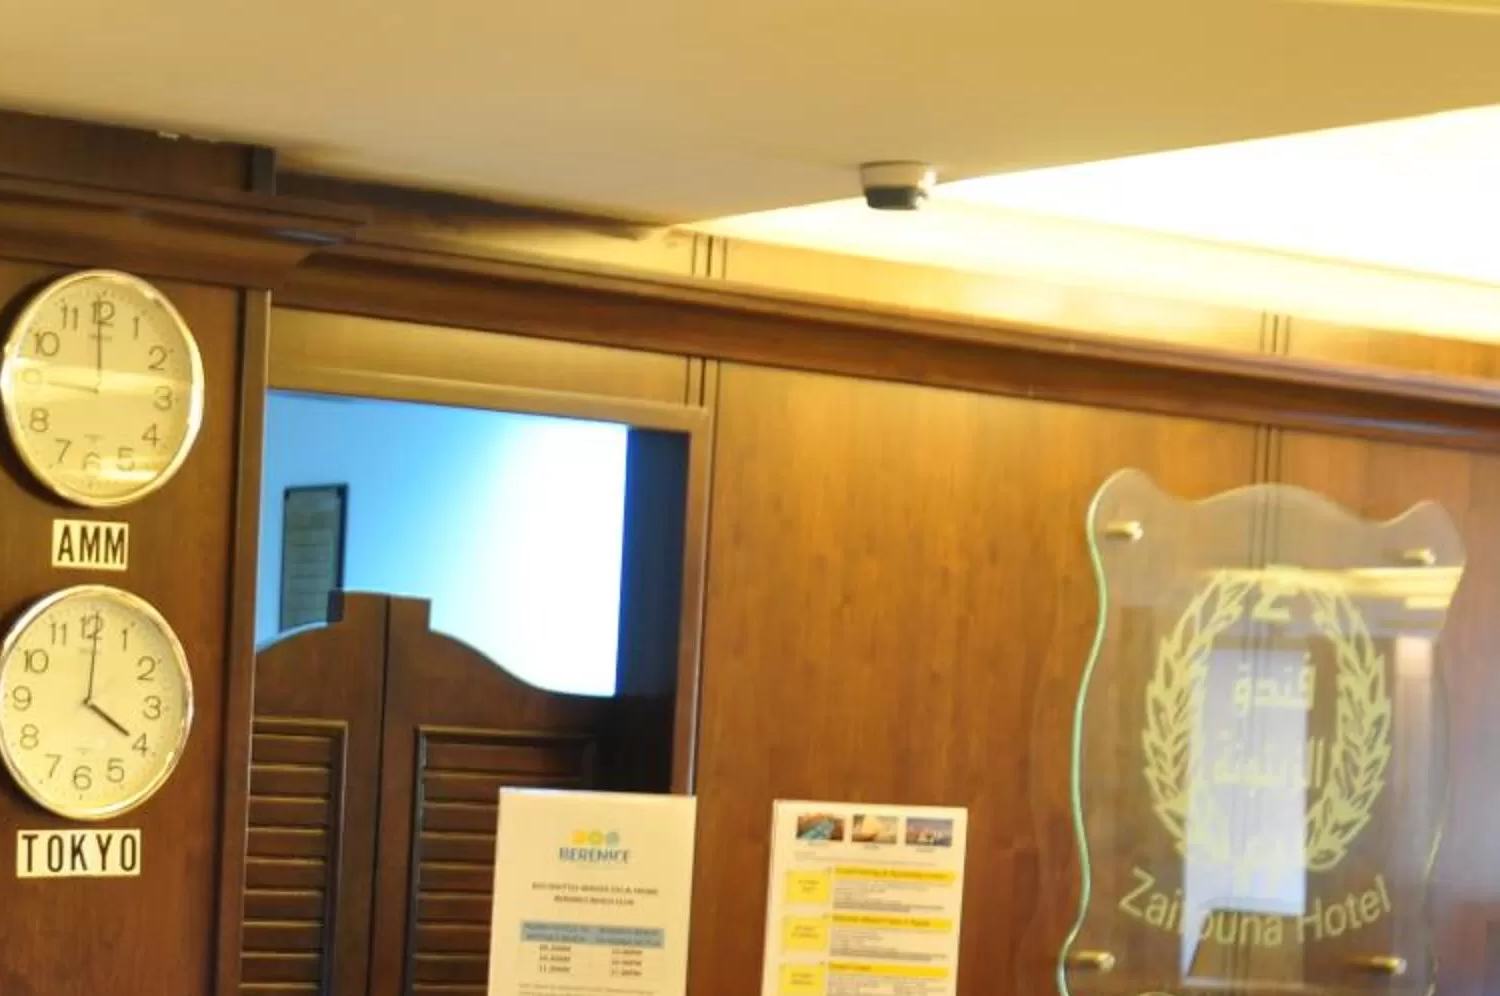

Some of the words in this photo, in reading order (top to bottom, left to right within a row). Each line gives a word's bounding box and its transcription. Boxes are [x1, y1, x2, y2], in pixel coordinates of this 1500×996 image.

[60, 304, 78, 331] 11
[90, 300, 116, 326] 12
[132, 316, 140, 340] 1
[34, 331, 60, 356] 10
[148, 346, 168, 371] 2
[153, 386, 172, 411] 3
[30, 408, 50, 433] 8
[141, 423, 161, 448] 4
[55, 438, 72, 464] 7
[57, 525, 125, 564] AMM
[50, 622, 67, 645] 11
[80, 614, 104, 640] 12
[120, 628, 128, 651] 1
[24, 649, 49, 674] 10
[137, 656, 156, 681] 2
[12, 686, 32, 711] 9
[143, 695, 161, 720] 3
[20, 724, 39, 749] 8
[132, 733, 148, 756] 4
[45, 754, 62, 778] 7
[73, 766, 92, 790] 6
[107, 758, 125, 783] 5
[22, 834, 137, 872] TOKYO
[1119, 866, 1283, 946] Zaiuna
[1299, 873, 1391, 940] Hotel
